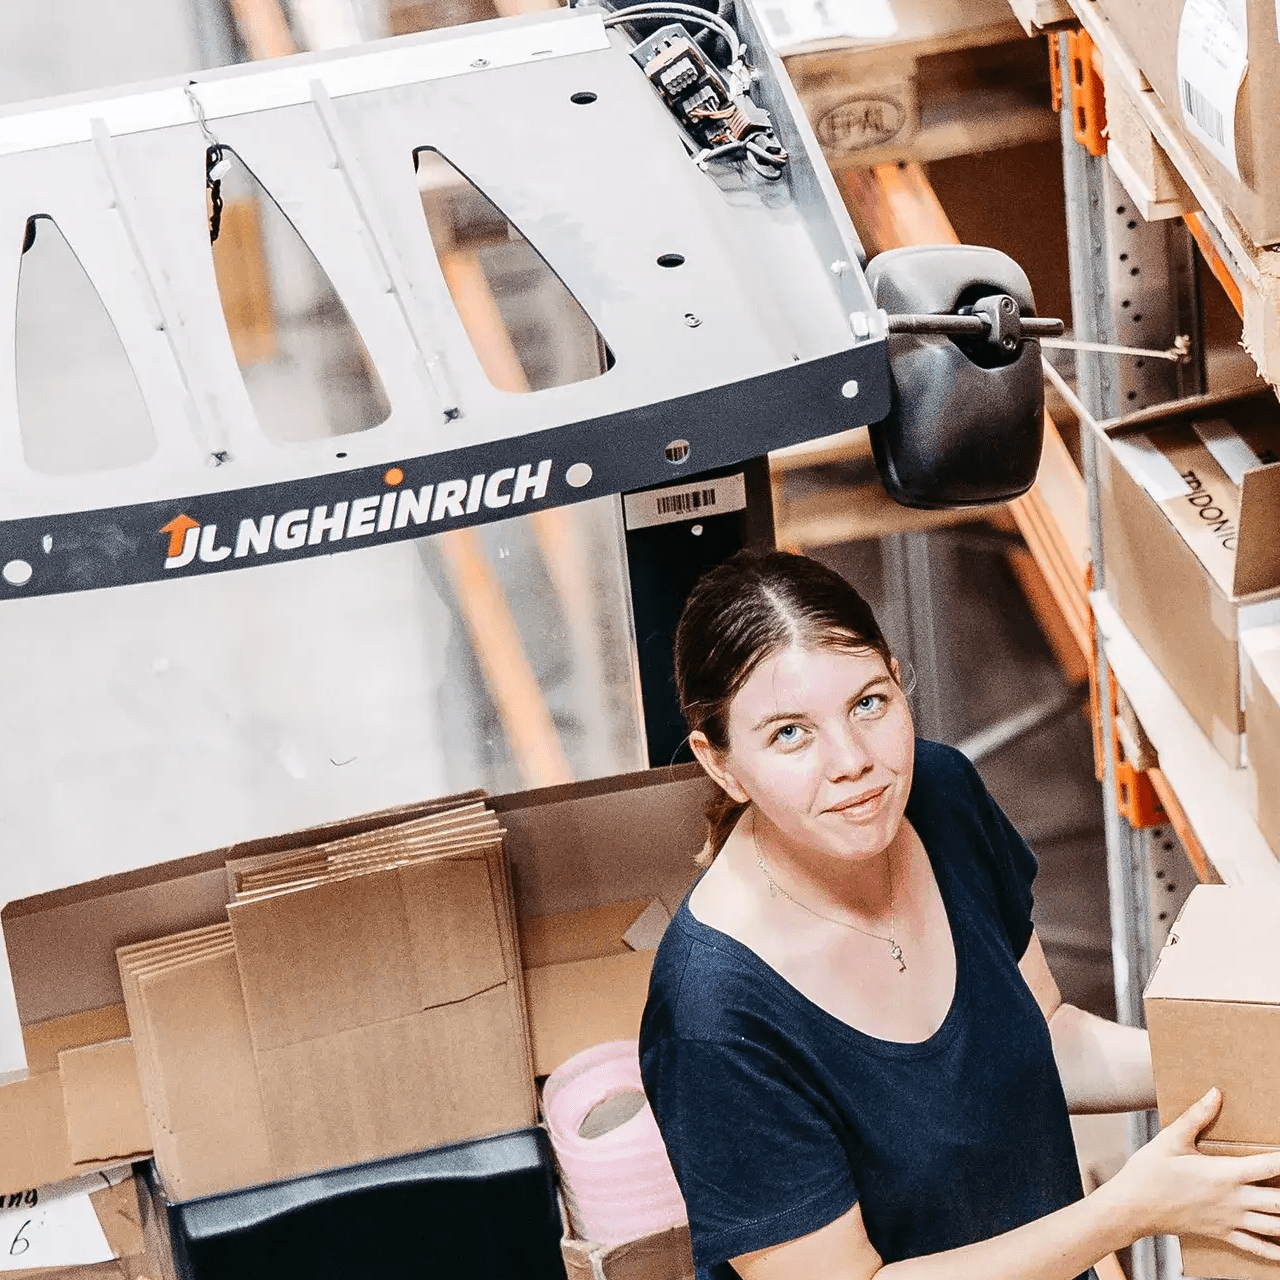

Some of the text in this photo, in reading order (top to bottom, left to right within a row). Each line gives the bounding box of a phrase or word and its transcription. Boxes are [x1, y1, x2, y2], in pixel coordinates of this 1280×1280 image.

[160, 459, 553, 570] JUNGHEINRICH
[1181, 470, 1236, 552] TRIDONIC
[9, 1219, 31, 1255] 6
